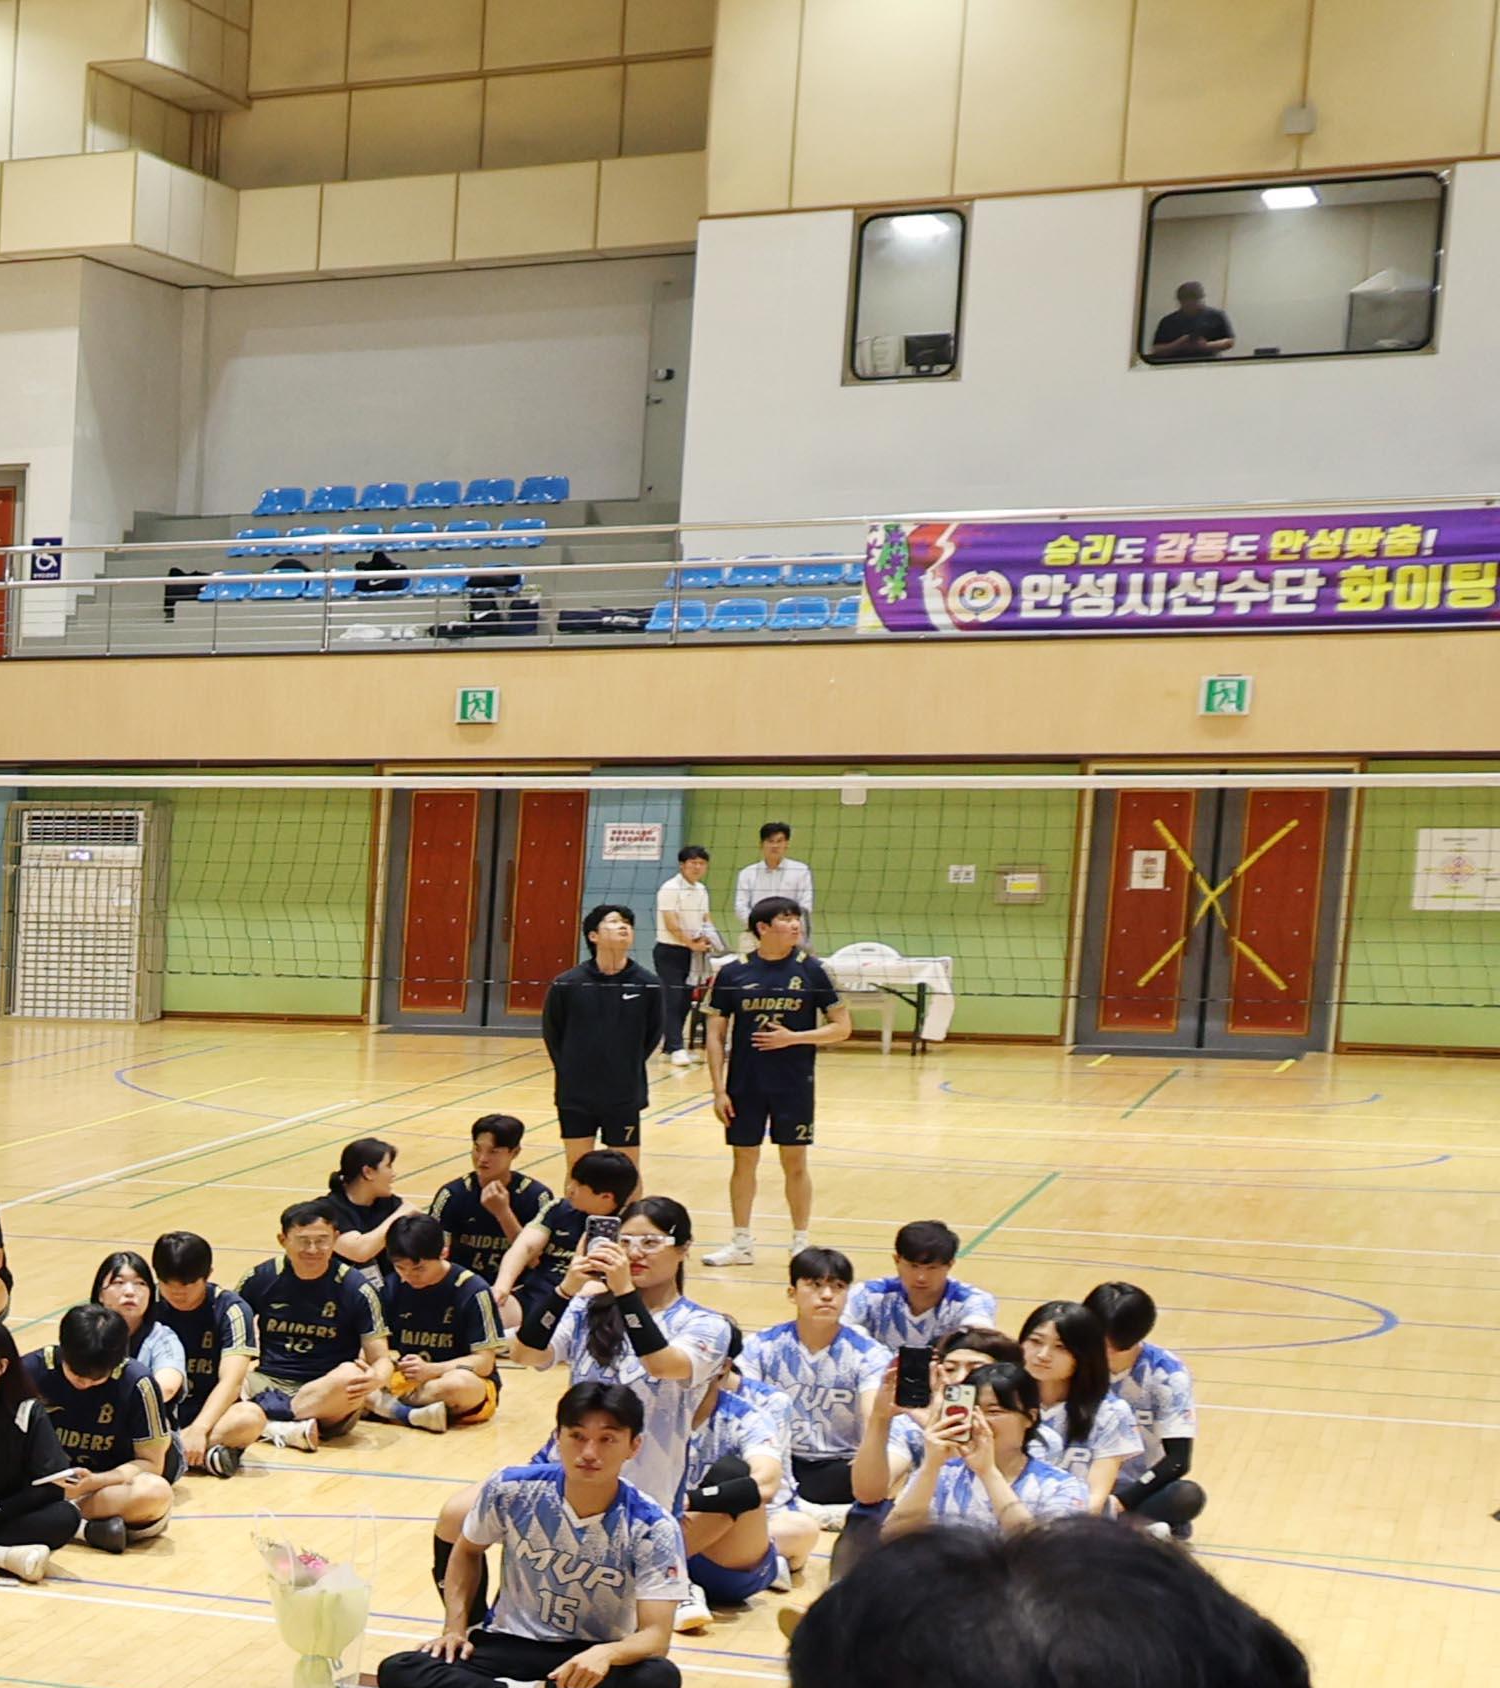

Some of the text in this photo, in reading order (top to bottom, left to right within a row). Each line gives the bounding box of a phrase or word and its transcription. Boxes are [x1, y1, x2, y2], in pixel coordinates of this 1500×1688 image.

[1042, 525, 1438, 567] 승리도 감동도 안성맞춤!
[1019, 560, 1499, 619] 안성시선수단 화이팅
[742, 998, 802, 1011] RAIDERS
[624, 1125, 636, 1142] 7
[266, 1317, 338, 1339] RAIDERS
[55, 1427, 115, 1451] AIDERS
[516, 1538, 625, 1590] MVP
[539, 1588, 581, 1634] 15
